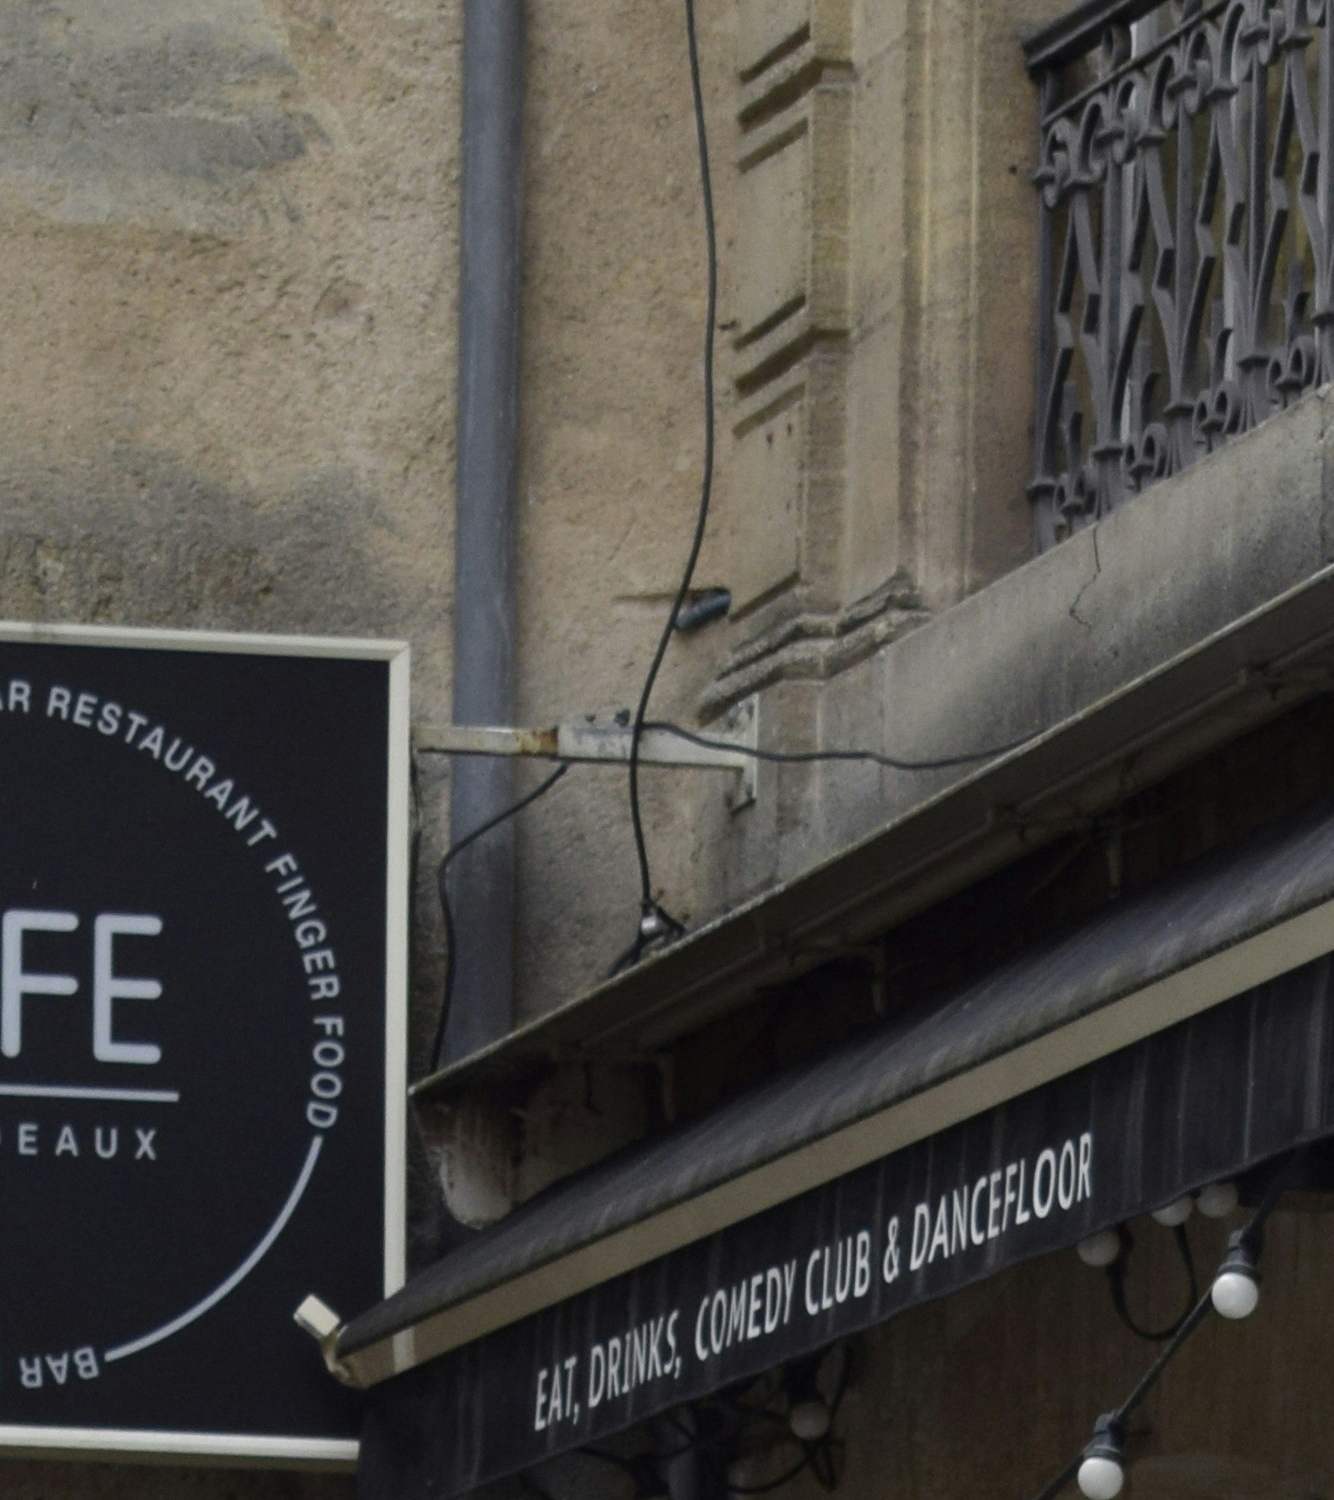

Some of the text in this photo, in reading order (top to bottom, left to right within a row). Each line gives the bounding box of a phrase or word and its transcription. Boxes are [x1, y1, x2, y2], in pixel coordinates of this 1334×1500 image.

[46, 686, 277, 847] RESTAURANT
[265, 852, 341, 1001] FINGER
[306, 1015, 346, 1129] FOOD
[19, 1346, 100, 1389] BAR
[534, 1131, 1093, 1430] EAT, DRINKS, COMEDY CLUB & DANCEFLOOR
